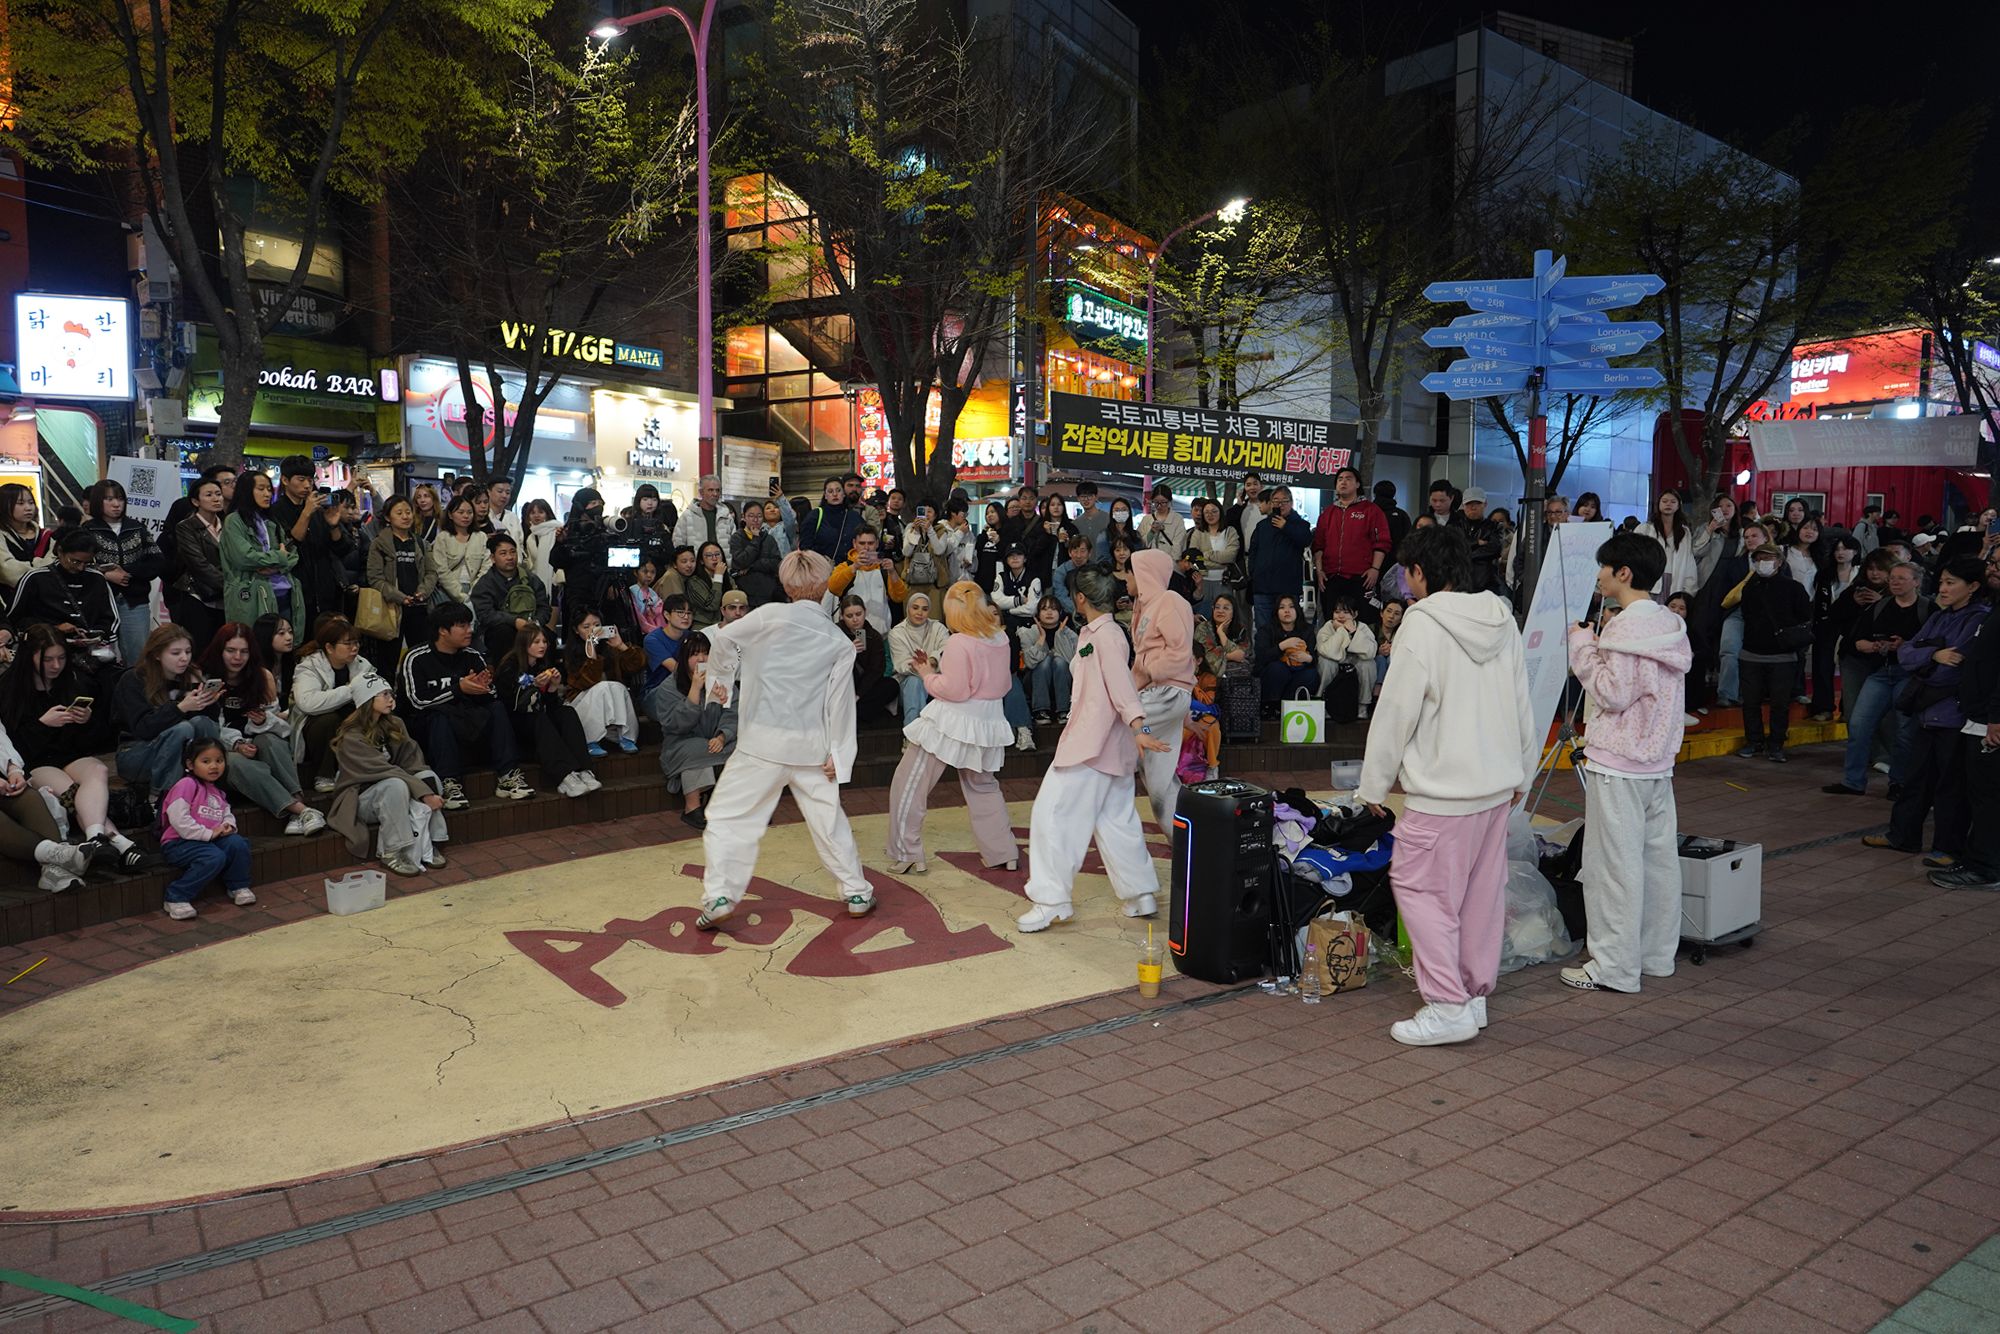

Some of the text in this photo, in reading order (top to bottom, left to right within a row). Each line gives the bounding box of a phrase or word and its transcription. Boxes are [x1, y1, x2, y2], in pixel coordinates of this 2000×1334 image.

[258, 288, 317, 312] Vinage
[1586, 295, 1618, 306] Moscow
[1598, 327, 1631, 337] London
[617, 346, 661, 367] MANIA
[1590, 343, 1617, 354] Beijing
[258, 366, 376, 397] ookah BAR
[1604, 374, 1629, 383] Berlin
[1101, 402, 1328, 444] 국토교통부는 처음 계획대로
[637, 434, 672, 452] Stella
[1061, 423, 1169, 460] 전철역사를
[1173, 433, 1212, 463] 홍대
[1215, 438, 1285, 470] 사거리에
[1285, 444, 1317, 474] 설치
[629, 450, 681, 472] Piercing
[1153, 463, 1191, 475] 대장홍대선
[149, 499, 161, 508] QR
